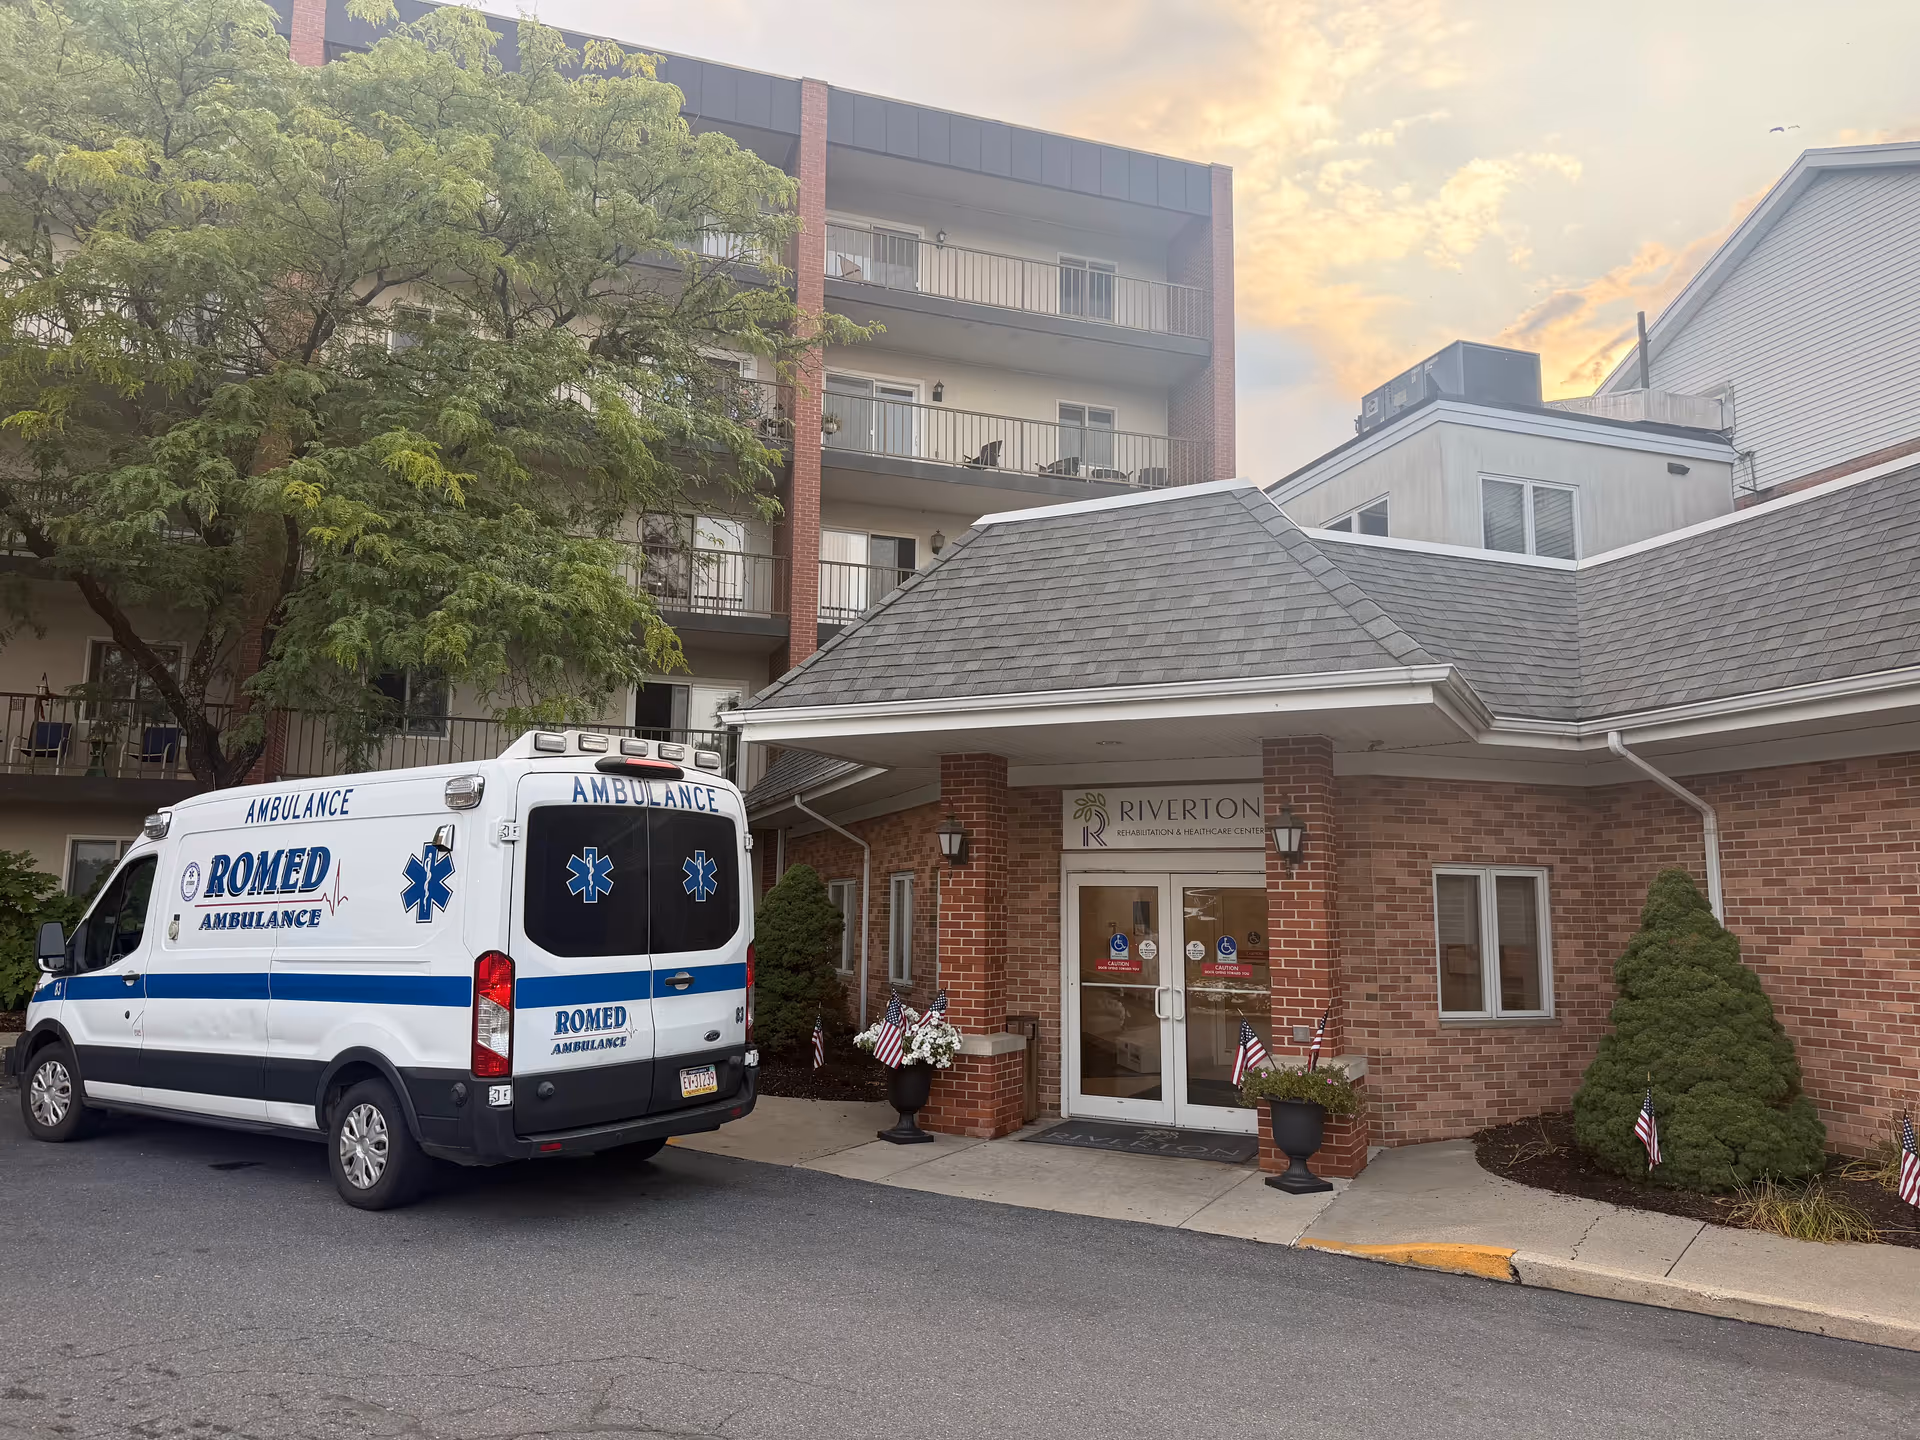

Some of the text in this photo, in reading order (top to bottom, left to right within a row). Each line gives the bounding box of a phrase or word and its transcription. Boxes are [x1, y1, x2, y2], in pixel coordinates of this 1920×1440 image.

[245, 788, 353, 824] AMBULANCE
[572, 775, 719, 813] AMBULANCE
[1120, 797, 1260, 822] RIVERTON
[1116, 829, 1174, 837] REHABILITATION
[1184, 828, 1232, 836] HEALTHCARE
[1234, 827, 1265, 835] CENTER
[203, 846, 331, 898] ROMED
[198, 908, 322, 931] AMBULANCE
[554, 1006, 627, 1035] ROMED
[551, 1036, 627, 1055] AMBULANCE
[1046, 1132, 1239, 1156] RIVERTON
